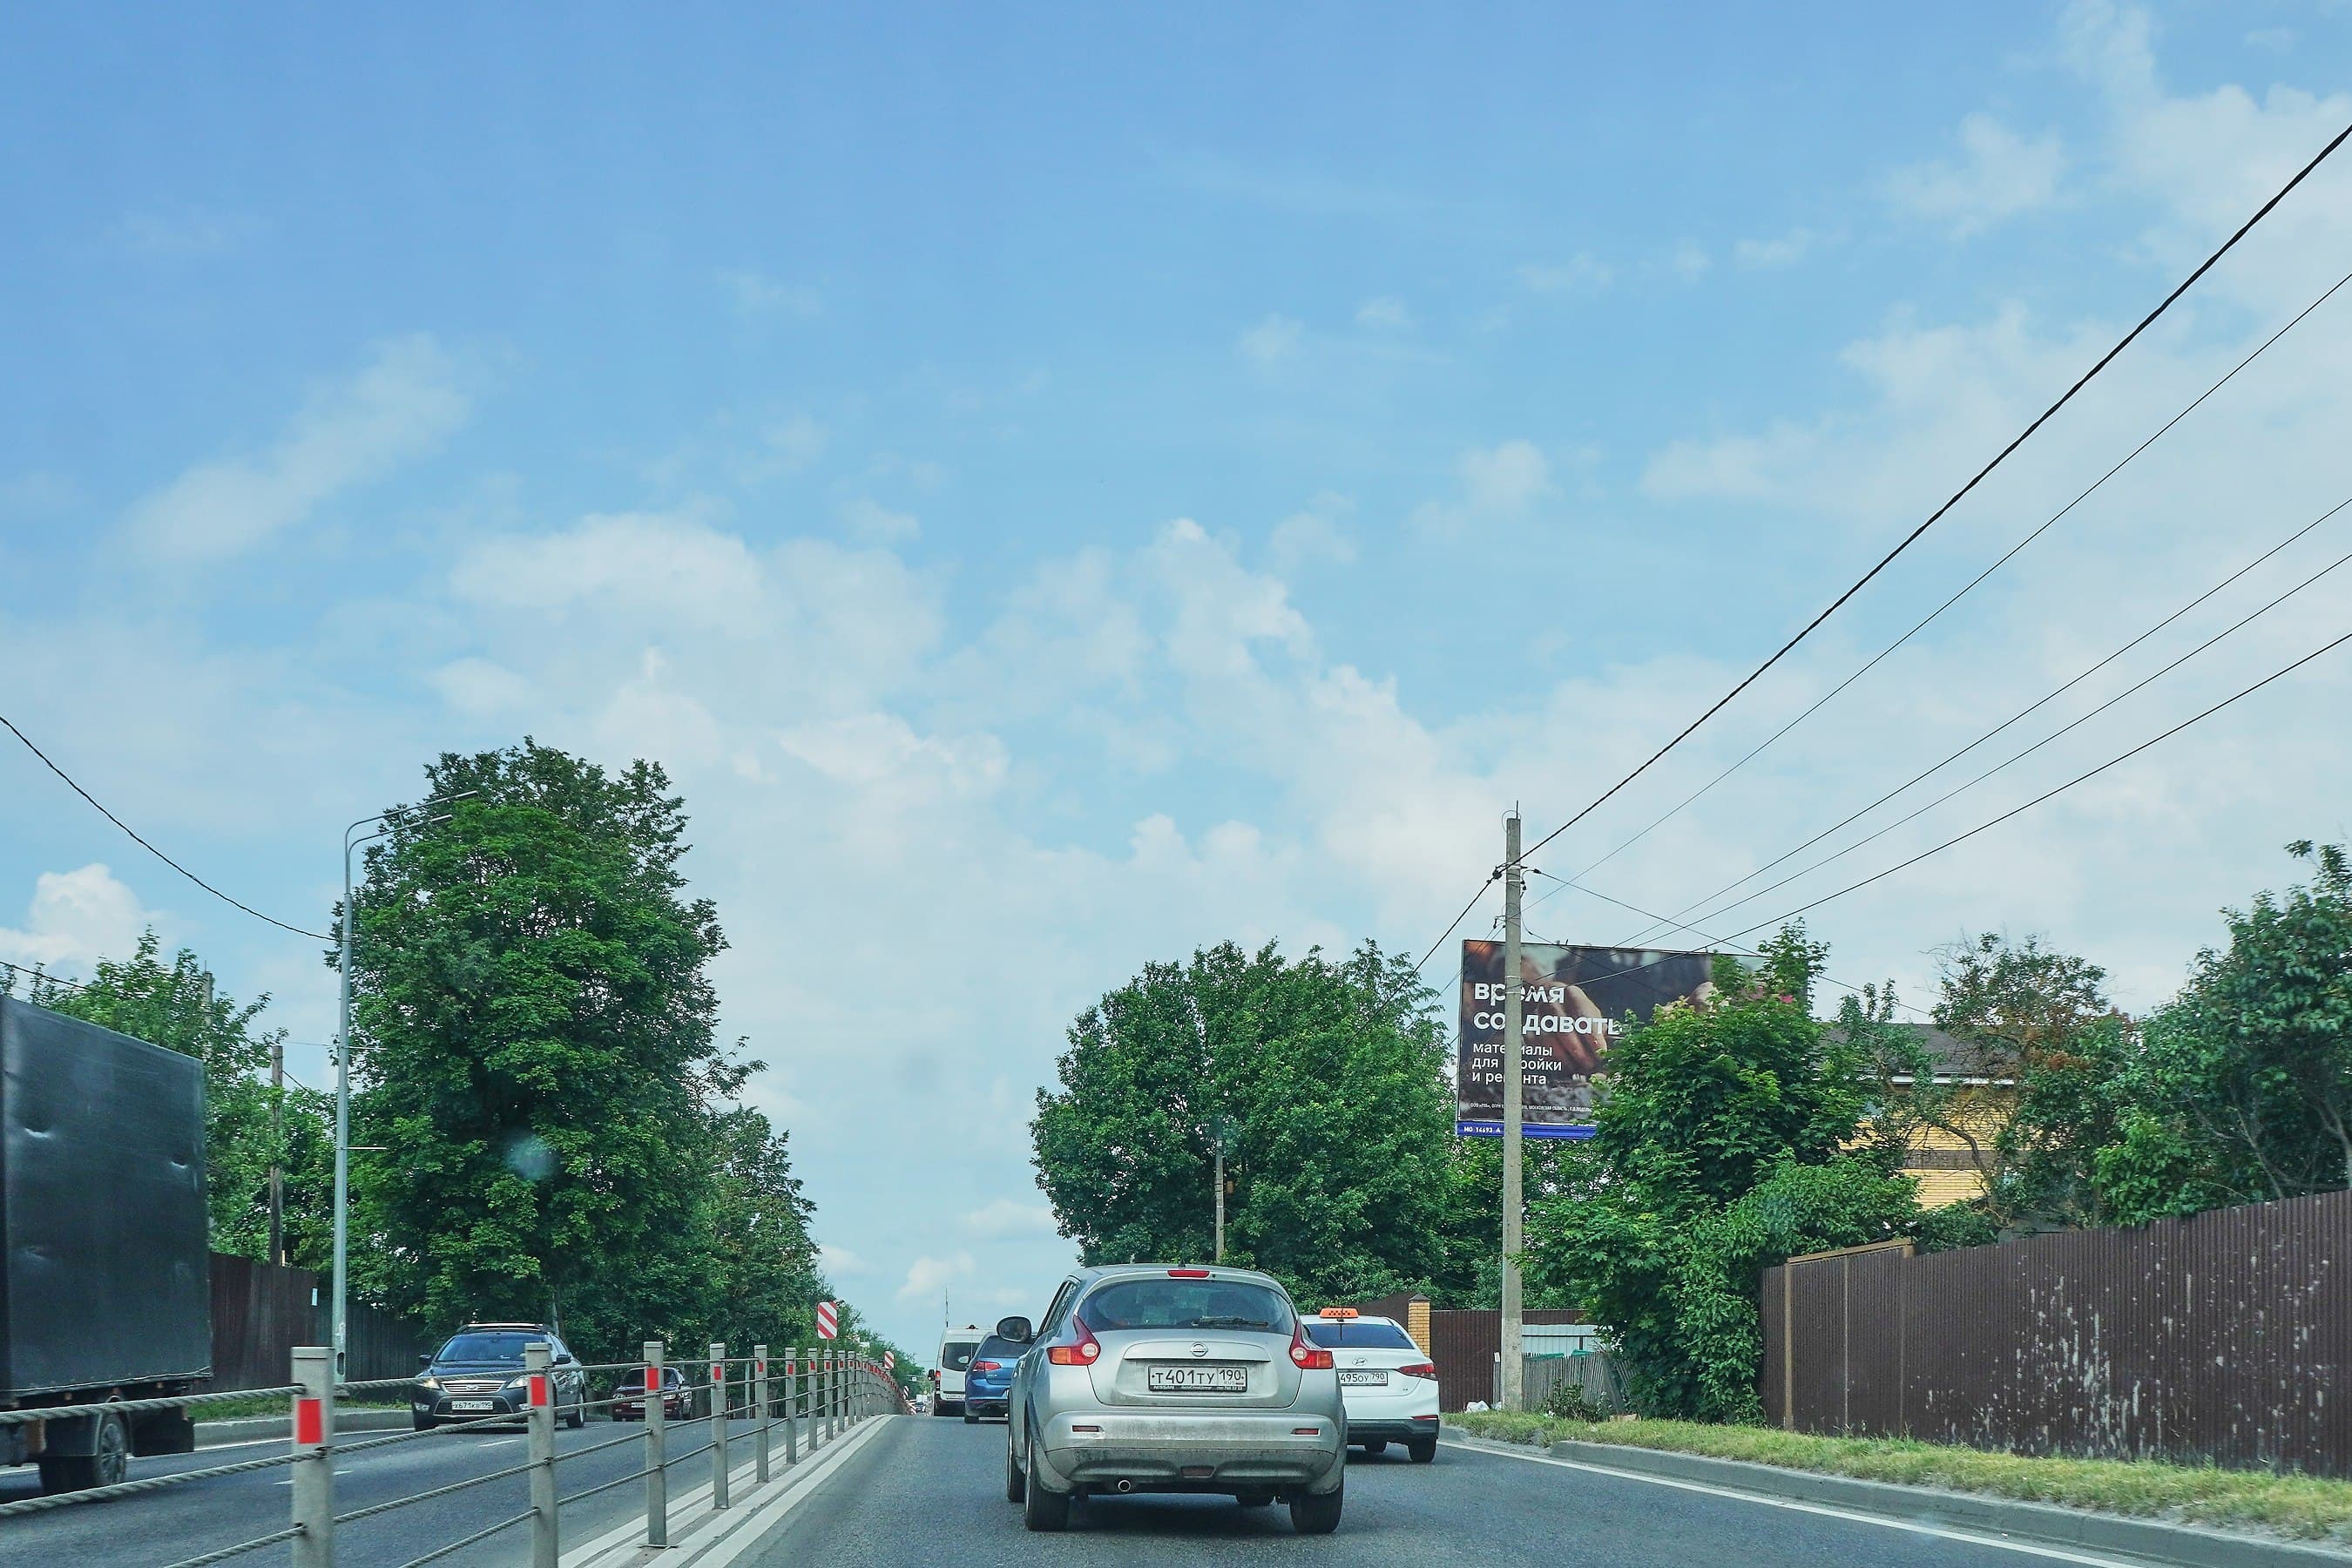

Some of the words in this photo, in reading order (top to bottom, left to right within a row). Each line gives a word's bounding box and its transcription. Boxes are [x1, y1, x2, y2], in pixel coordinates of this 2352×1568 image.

[1474, 983, 1565, 1006] врмя
[1473, 1011, 1623, 1036] содавать
[1473, 1043, 1553, 1057] матеалы
[1471, 1058, 1498, 1070] для
[1520, 1058, 1562, 1071] ройки
[1472, 1071, 1481, 1082] и
[1485, 1072, 1546, 1085] рента
[1155, 1369, 1214, 1384] Т401ТУ
[1219, 1369, 1241, 1381] 190
[1340, 1373, 1369, 1382] 495ОУ
